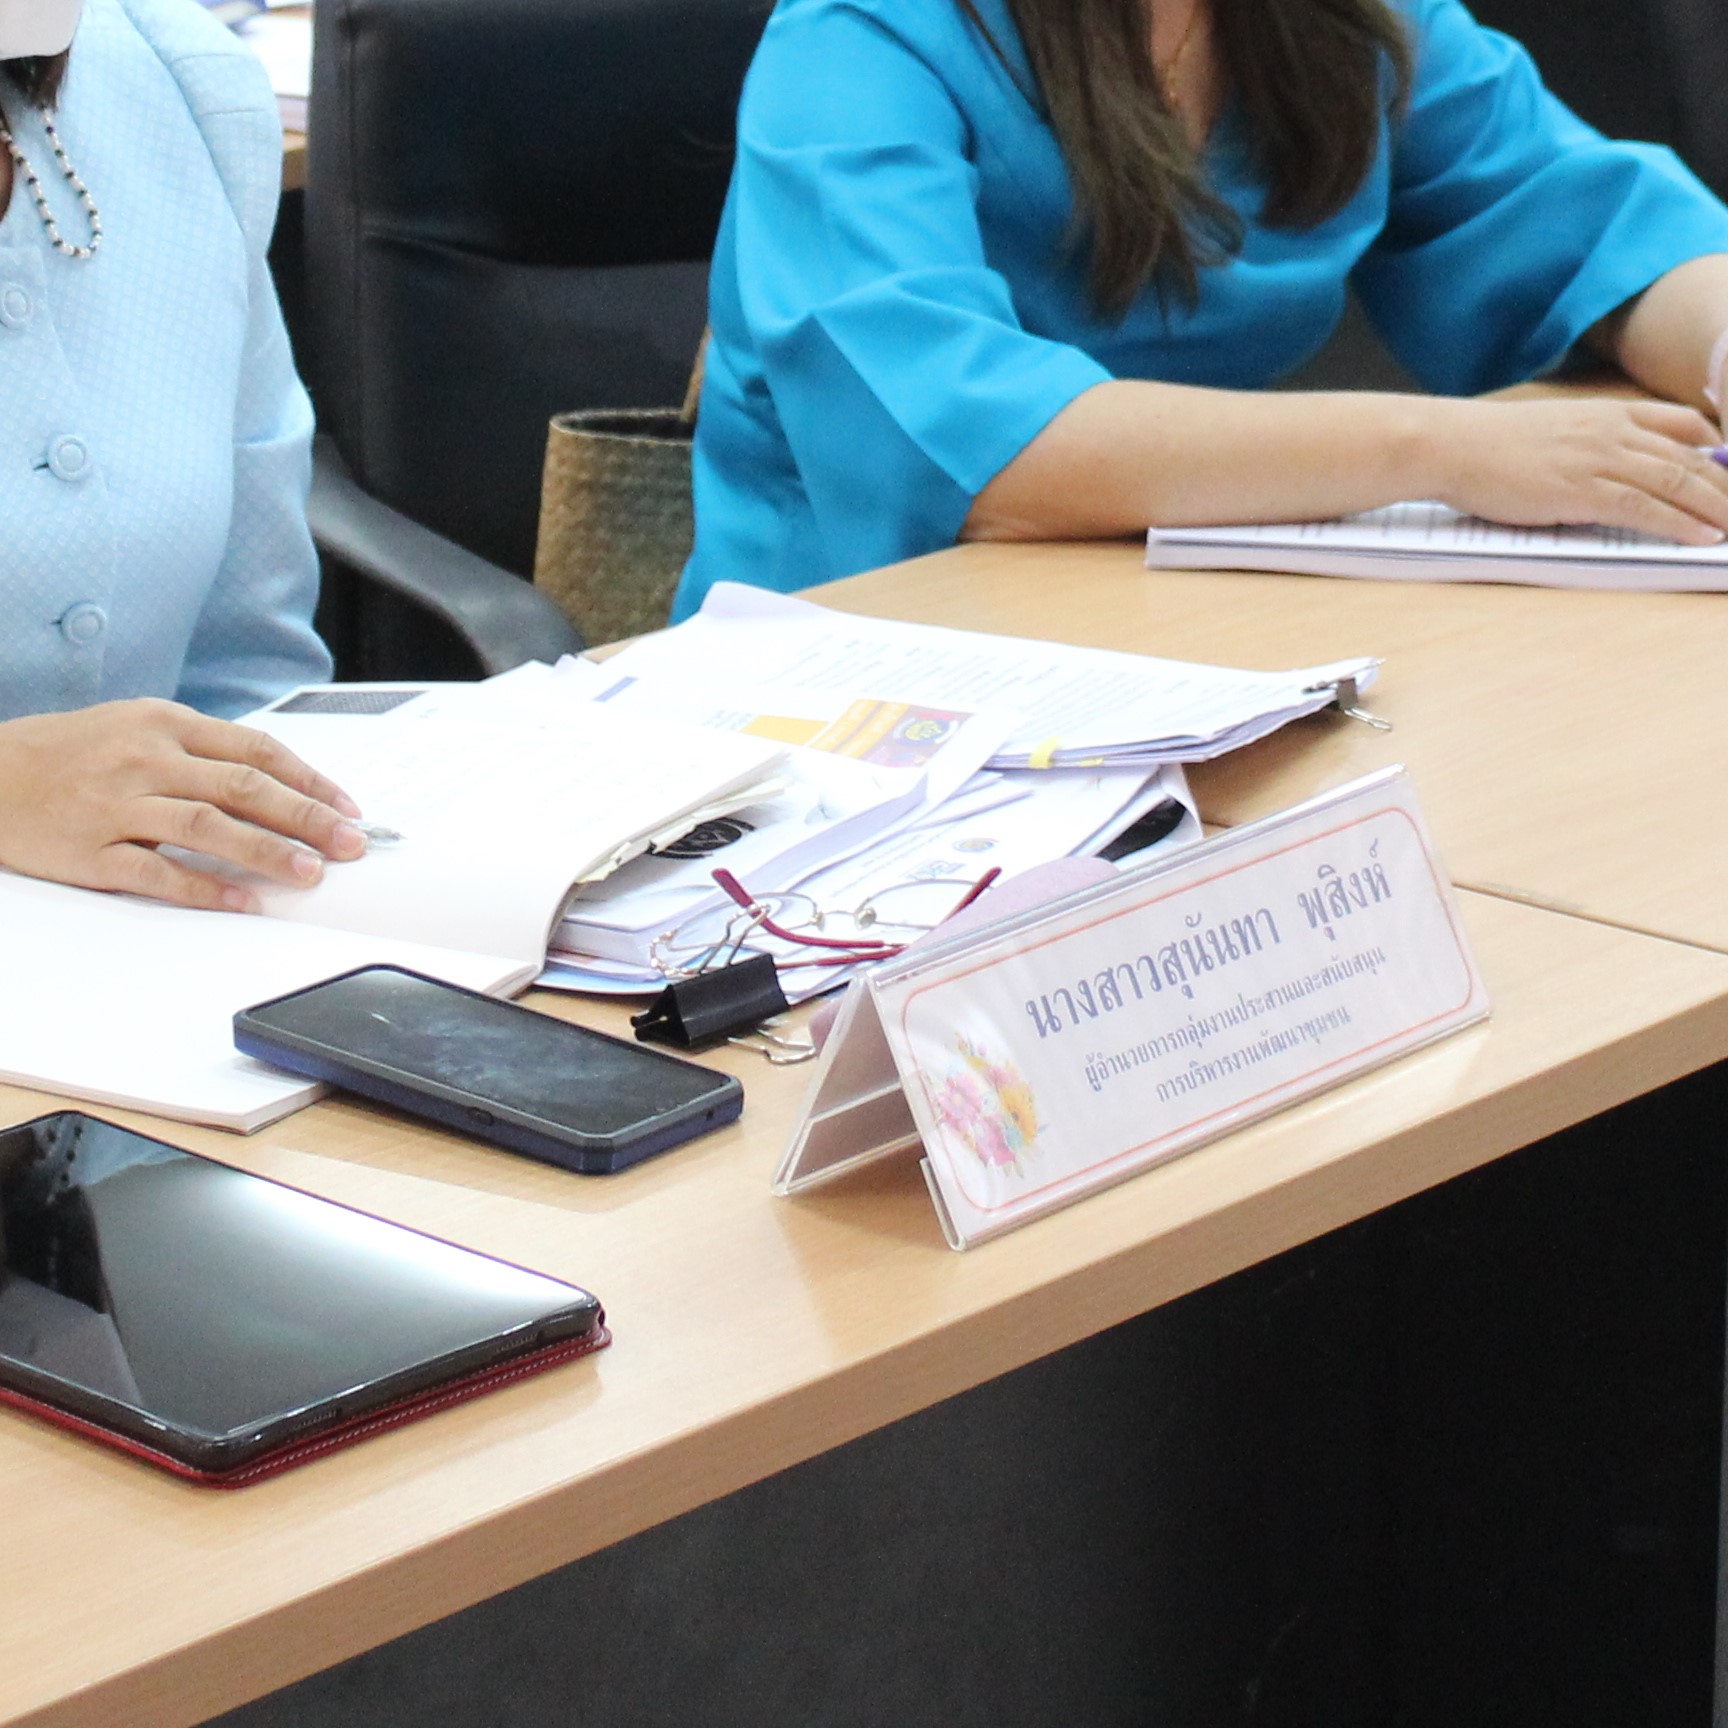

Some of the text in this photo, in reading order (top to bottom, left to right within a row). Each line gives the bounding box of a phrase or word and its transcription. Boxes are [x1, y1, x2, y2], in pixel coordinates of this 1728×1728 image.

[1025, 838, 1392, 1039] นางสาวสุนันทา พุสิงห์
[1083, 946, 1386, 1092] ผู้อำนวยการกลุ่มงานประสานและสนับสนุน
[1156, 1005, 1352, 1104] การบริหารงานพัฒนาชุมชน
